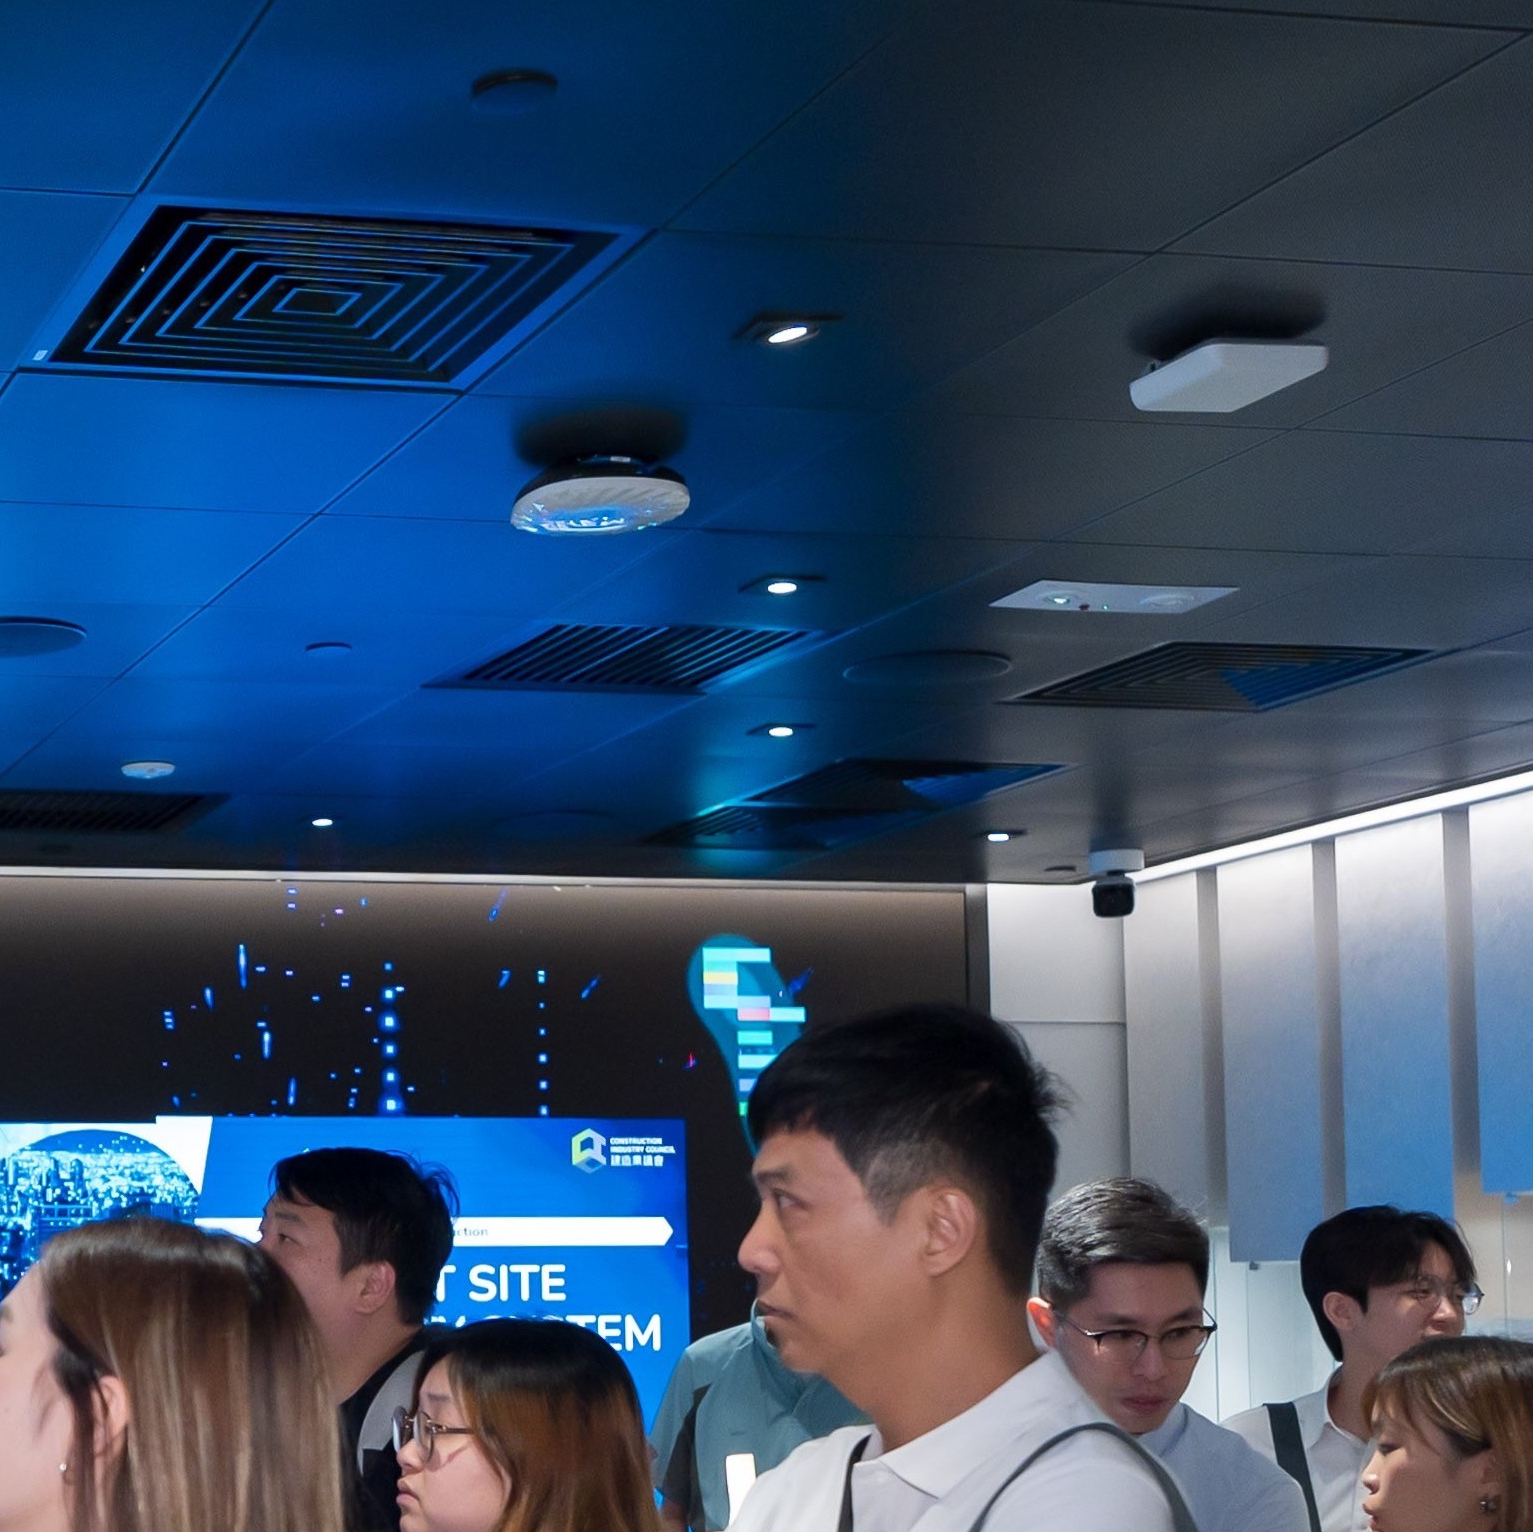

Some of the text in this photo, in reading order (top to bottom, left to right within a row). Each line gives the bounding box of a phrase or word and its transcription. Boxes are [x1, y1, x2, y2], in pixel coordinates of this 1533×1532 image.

[610, 1137, 663, 1145] CONSTRUCTION
[645, 1146, 676, 1154] COUNCIL
[454, 1228, 489, 1237] ction
[468, 1264, 566, 1302] SITE
